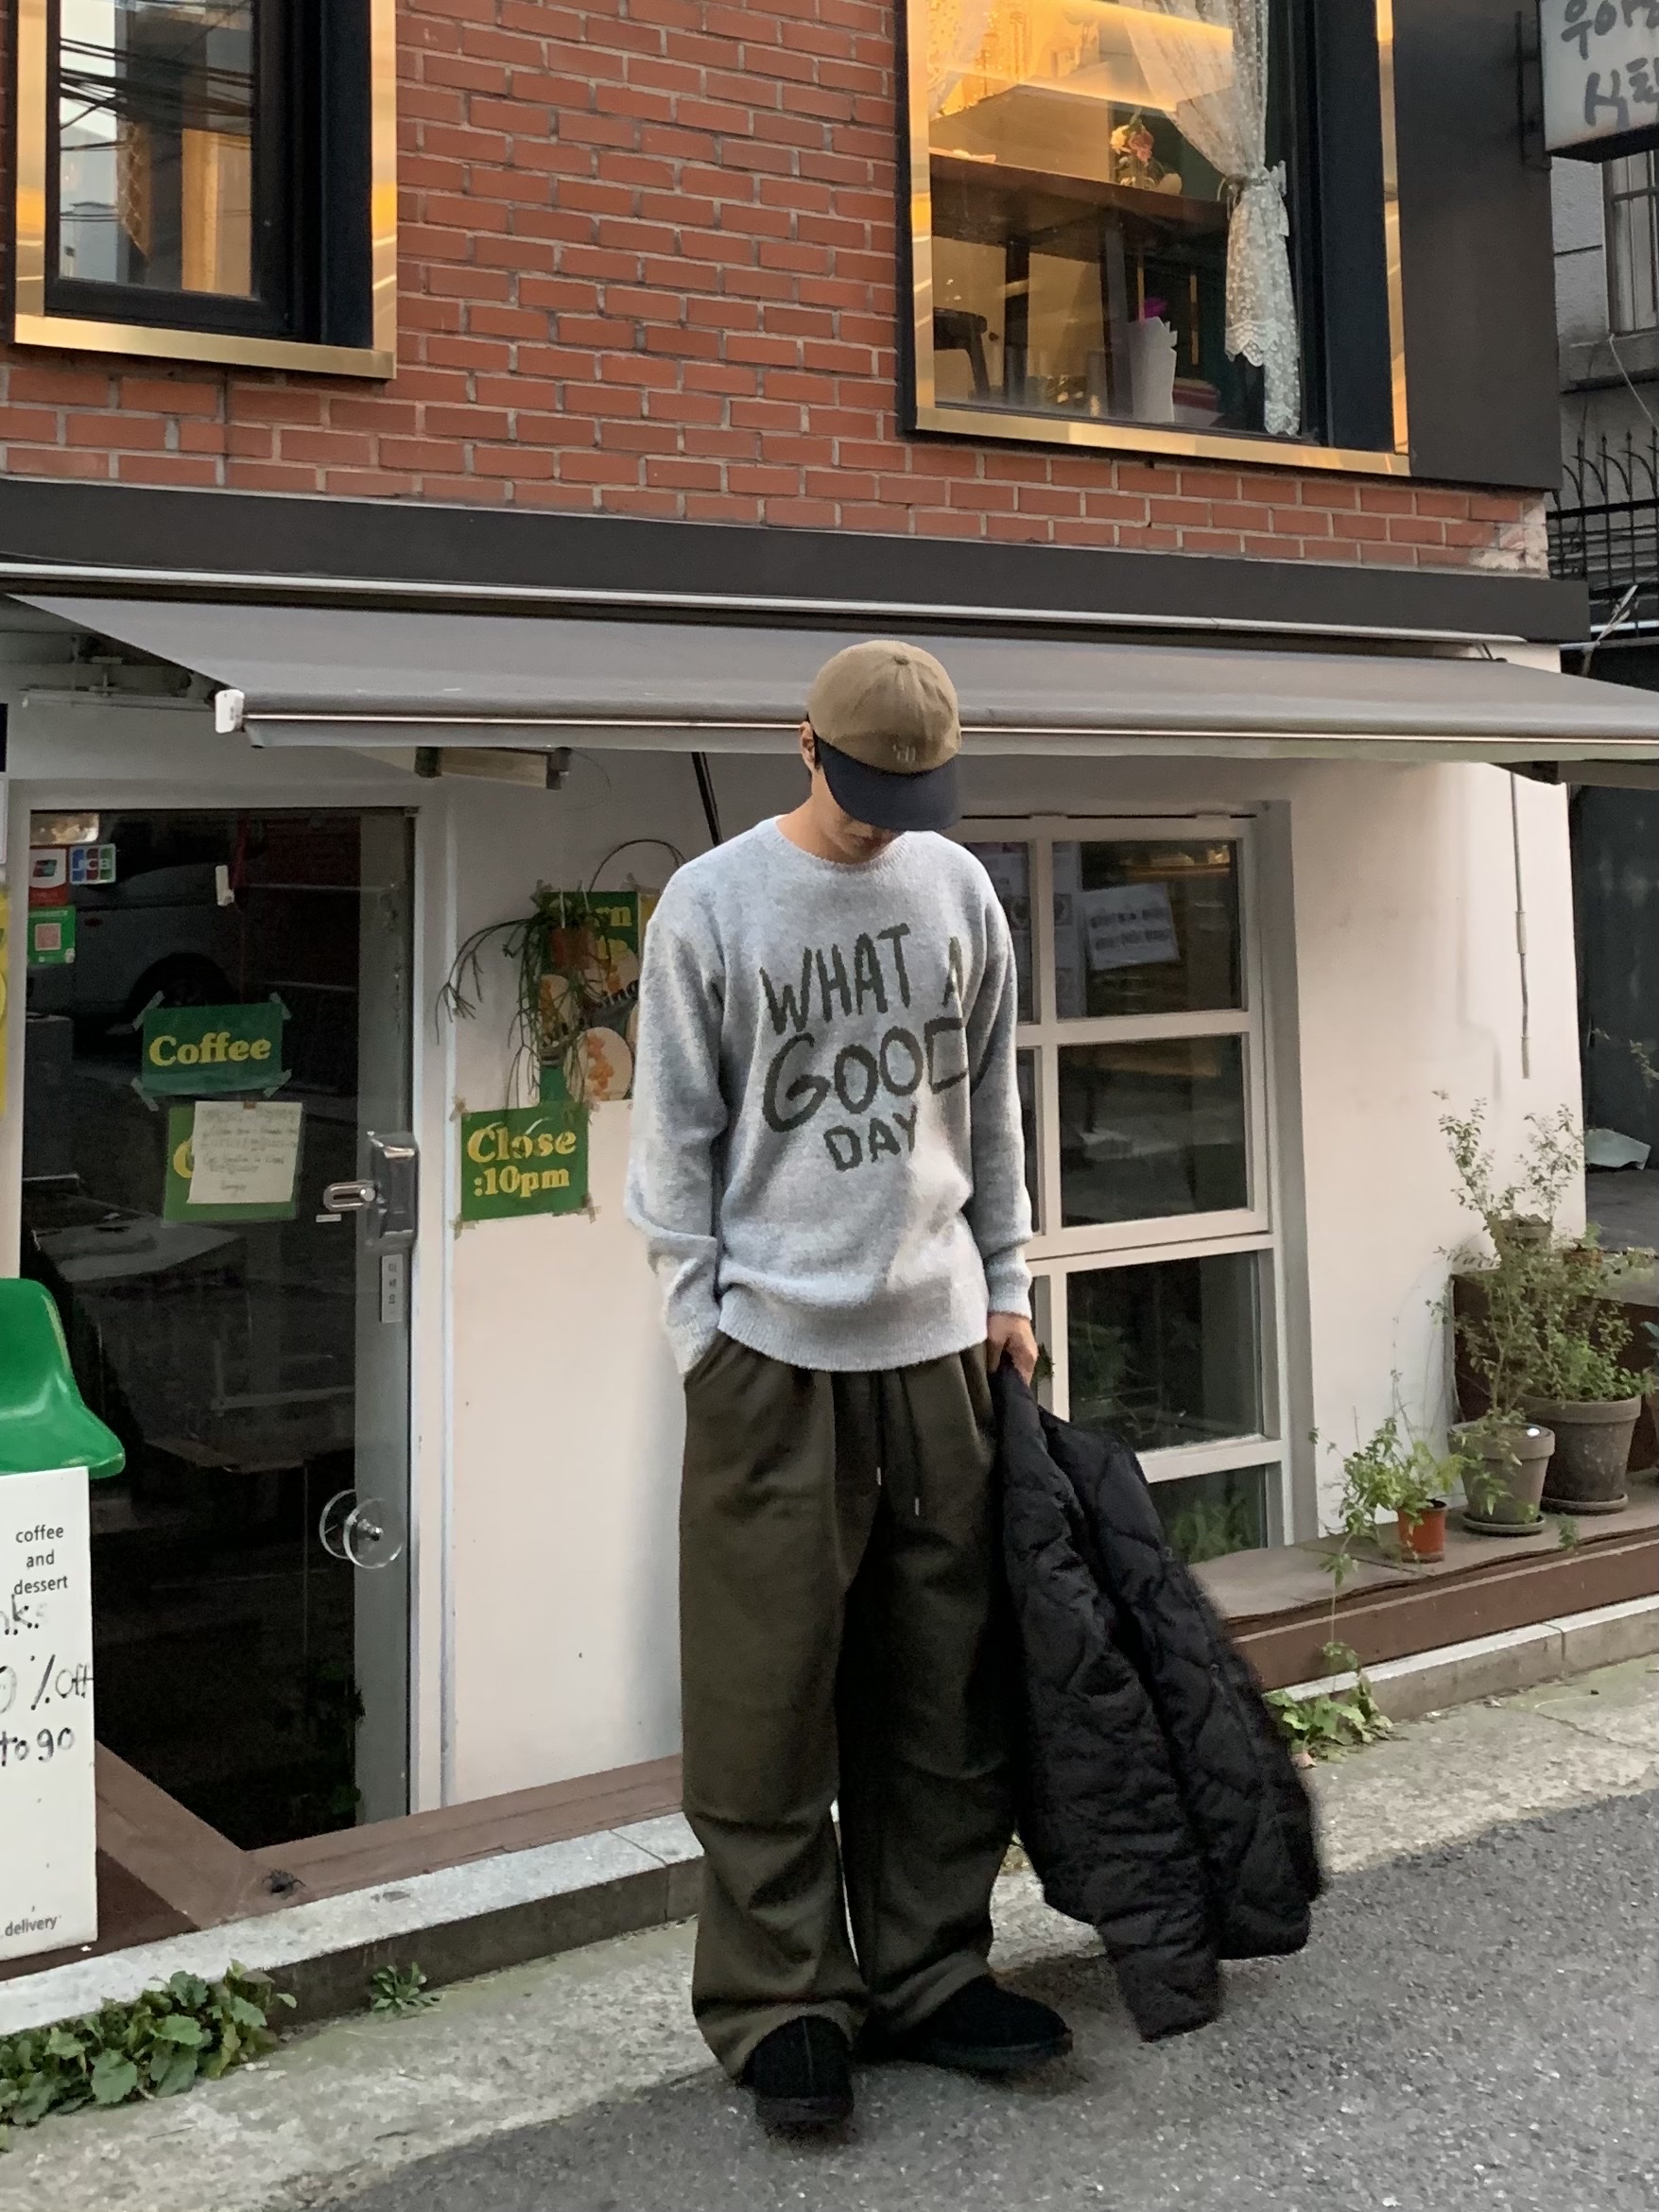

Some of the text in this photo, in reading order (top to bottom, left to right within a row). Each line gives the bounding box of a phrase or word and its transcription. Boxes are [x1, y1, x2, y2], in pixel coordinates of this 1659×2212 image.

[758, 923, 911, 1035] WHAT
[148, 1031, 271, 1066] Coffee
[467, 1126, 577, 1163] Close
[822, 1104, 918, 1171] DAY
[15, 1524, 64, 1544] coffee
[26, 1548, 55, 1568] and
[13, 1575, 69, 1596] dessert
[5, 1916, 58, 1937] delivery
